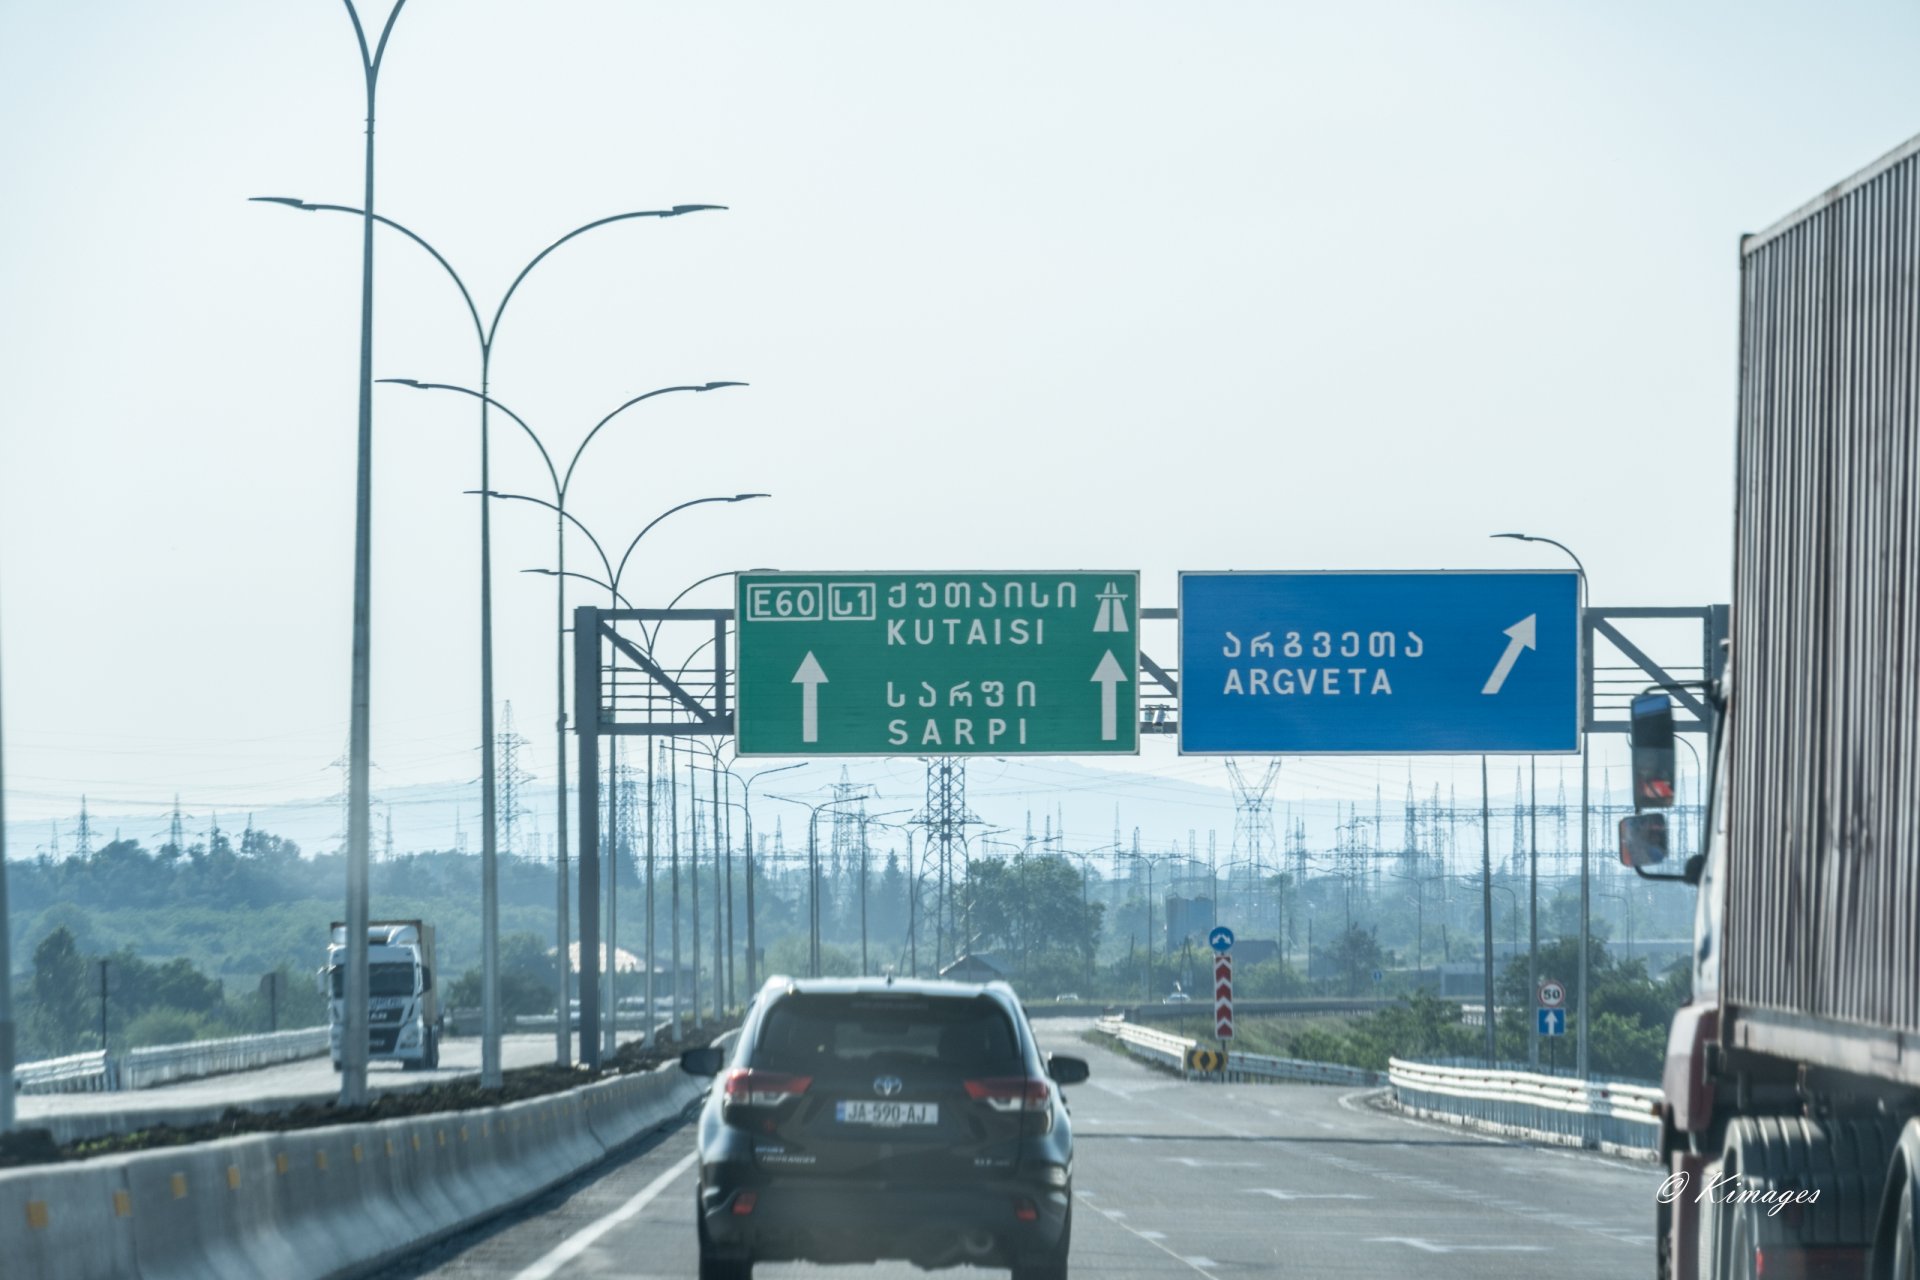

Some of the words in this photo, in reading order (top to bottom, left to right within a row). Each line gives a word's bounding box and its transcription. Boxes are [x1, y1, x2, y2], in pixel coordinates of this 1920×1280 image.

[754, 589, 815, 616] E60
[888, 581, 1076, 609] ქუთაისი
[887, 618, 1043, 646] KUTAISI
[1223, 631, 1423, 658] არგვეთა
[887, 680, 1036, 708] სარფი
[1223, 668, 1392, 695] ARGVETA
[888, 718, 1026, 746] SARPI
[1543, 989, 1560, 1000] 50
[848, 1103, 926, 1122] JA-590-AJ
